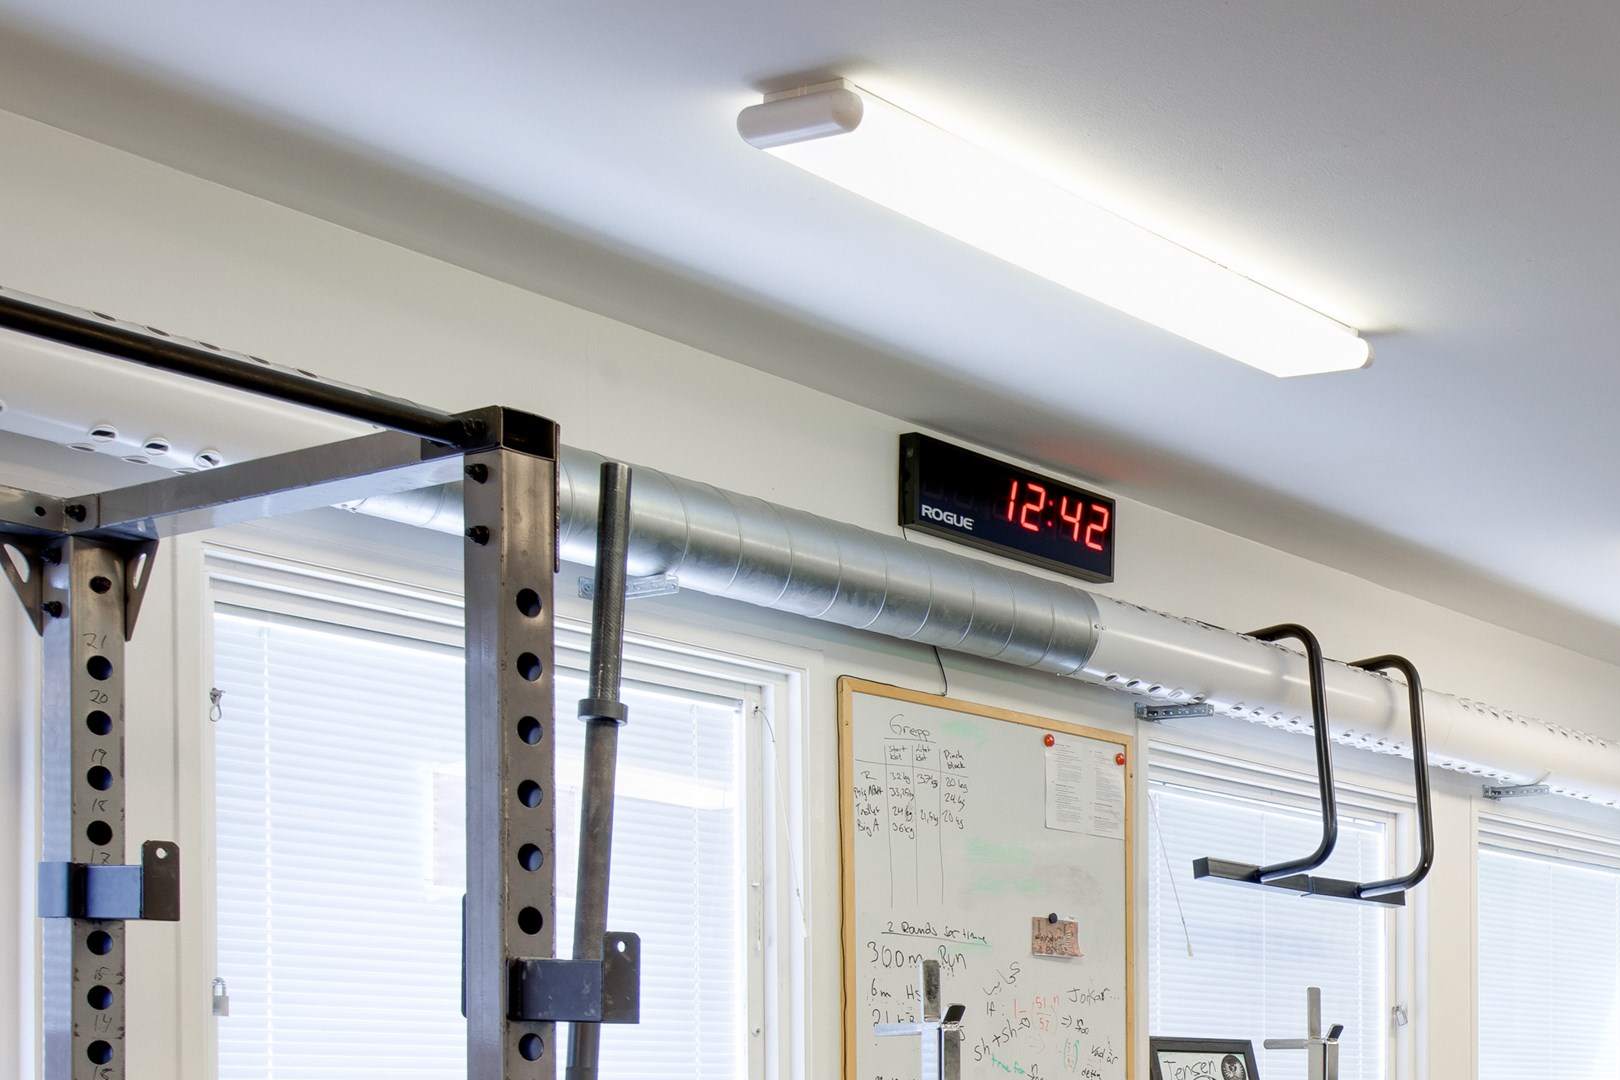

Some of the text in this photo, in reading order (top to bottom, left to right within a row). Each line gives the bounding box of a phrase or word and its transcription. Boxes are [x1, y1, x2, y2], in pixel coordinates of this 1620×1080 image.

[921, 503, 975, 531] ROGUE
[1006, 479, 1110, 552] 12:42
[889, 713, 931, 742] Grepp
